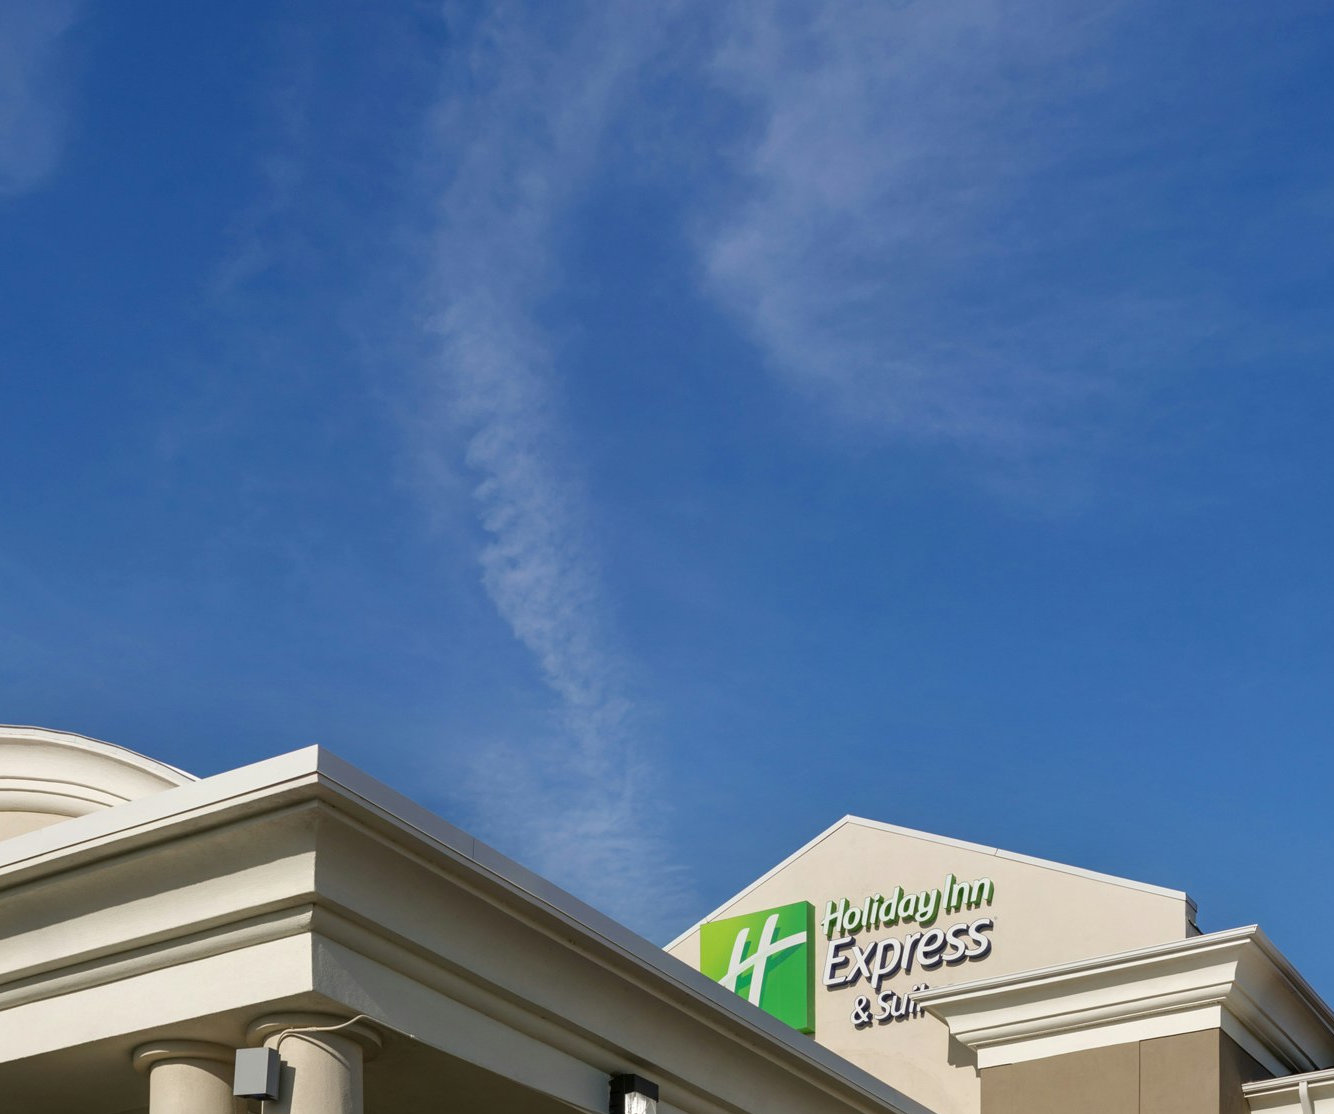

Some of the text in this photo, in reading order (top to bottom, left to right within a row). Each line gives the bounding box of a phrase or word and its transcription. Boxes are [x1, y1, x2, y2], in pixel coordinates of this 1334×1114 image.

[821, 873, 994, 939] Holiday Inn
[822, 918, 993, 990] Express
[850, 995, 873, 1027] &
